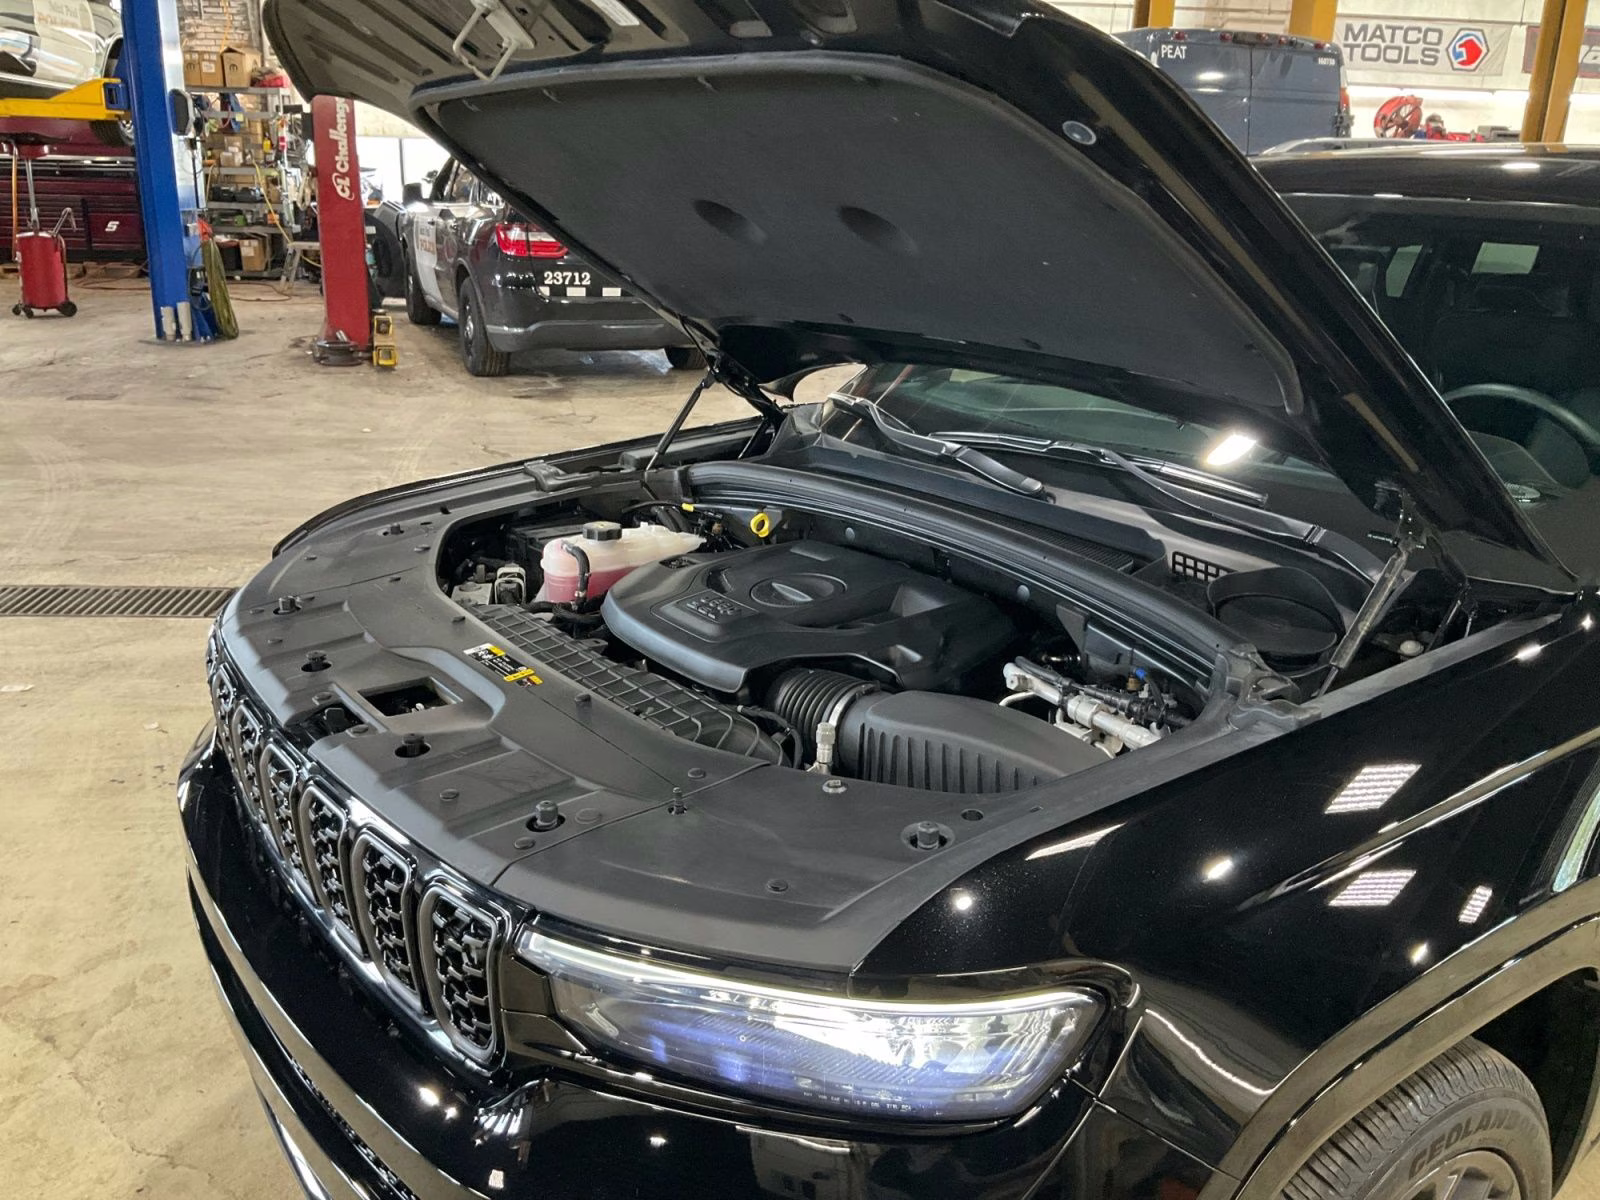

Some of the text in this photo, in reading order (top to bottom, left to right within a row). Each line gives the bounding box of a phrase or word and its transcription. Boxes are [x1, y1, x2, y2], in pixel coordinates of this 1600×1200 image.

[1343, 23, 1442, 46] MATCO
[1161, 44, 1187, 60] PEAT
[1343, 43, 1440, 66] TOOLS
[544, 271, 591, 285] 23712
